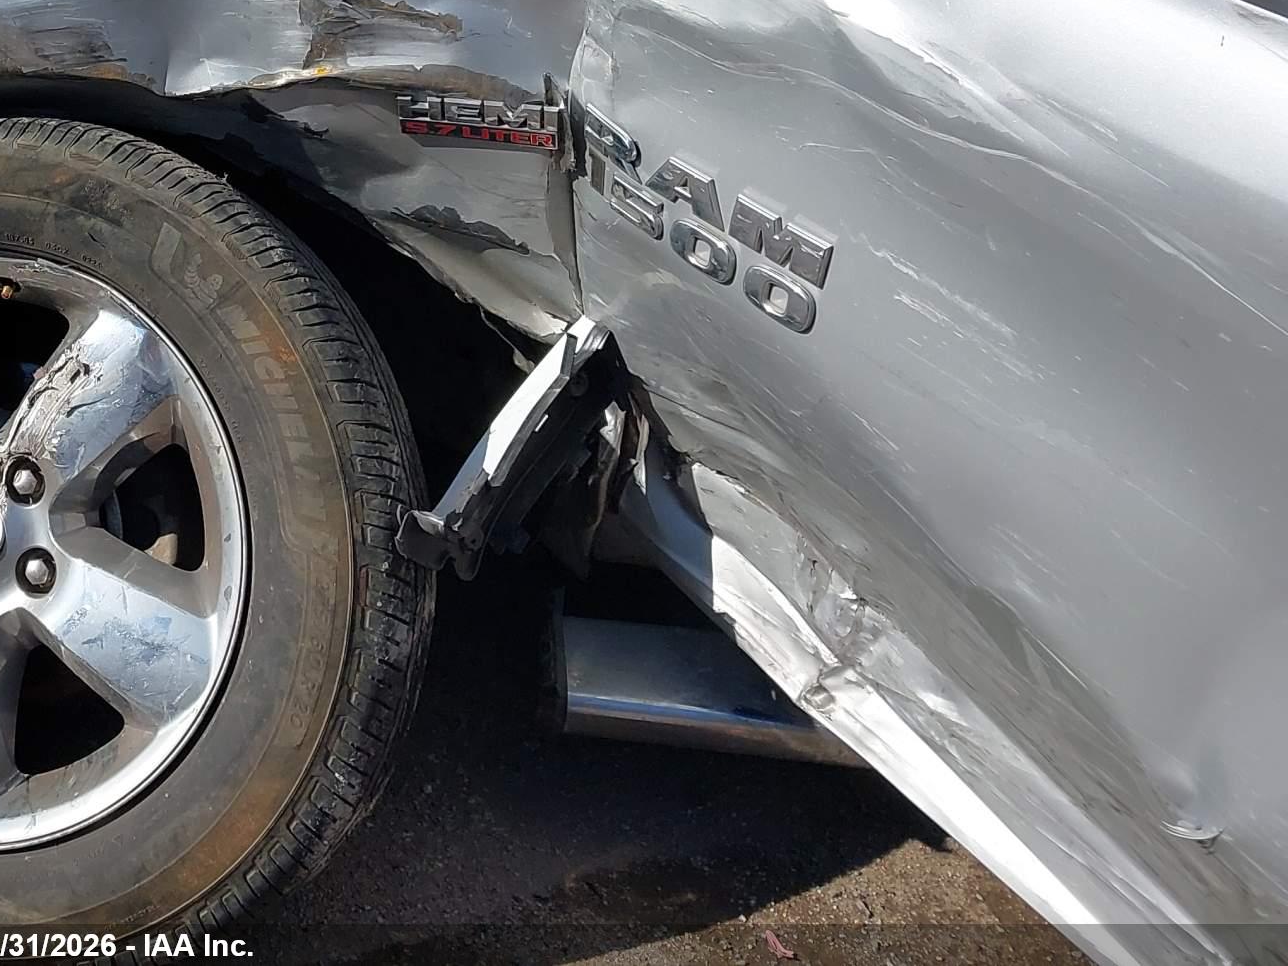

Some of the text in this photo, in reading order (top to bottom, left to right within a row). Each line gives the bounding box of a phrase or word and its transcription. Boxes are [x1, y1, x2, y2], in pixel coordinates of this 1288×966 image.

[396, 96, 564, 132] HEMI
[460, 123, 554, 147] LITER
[584, 101, 835, 291] RAM
